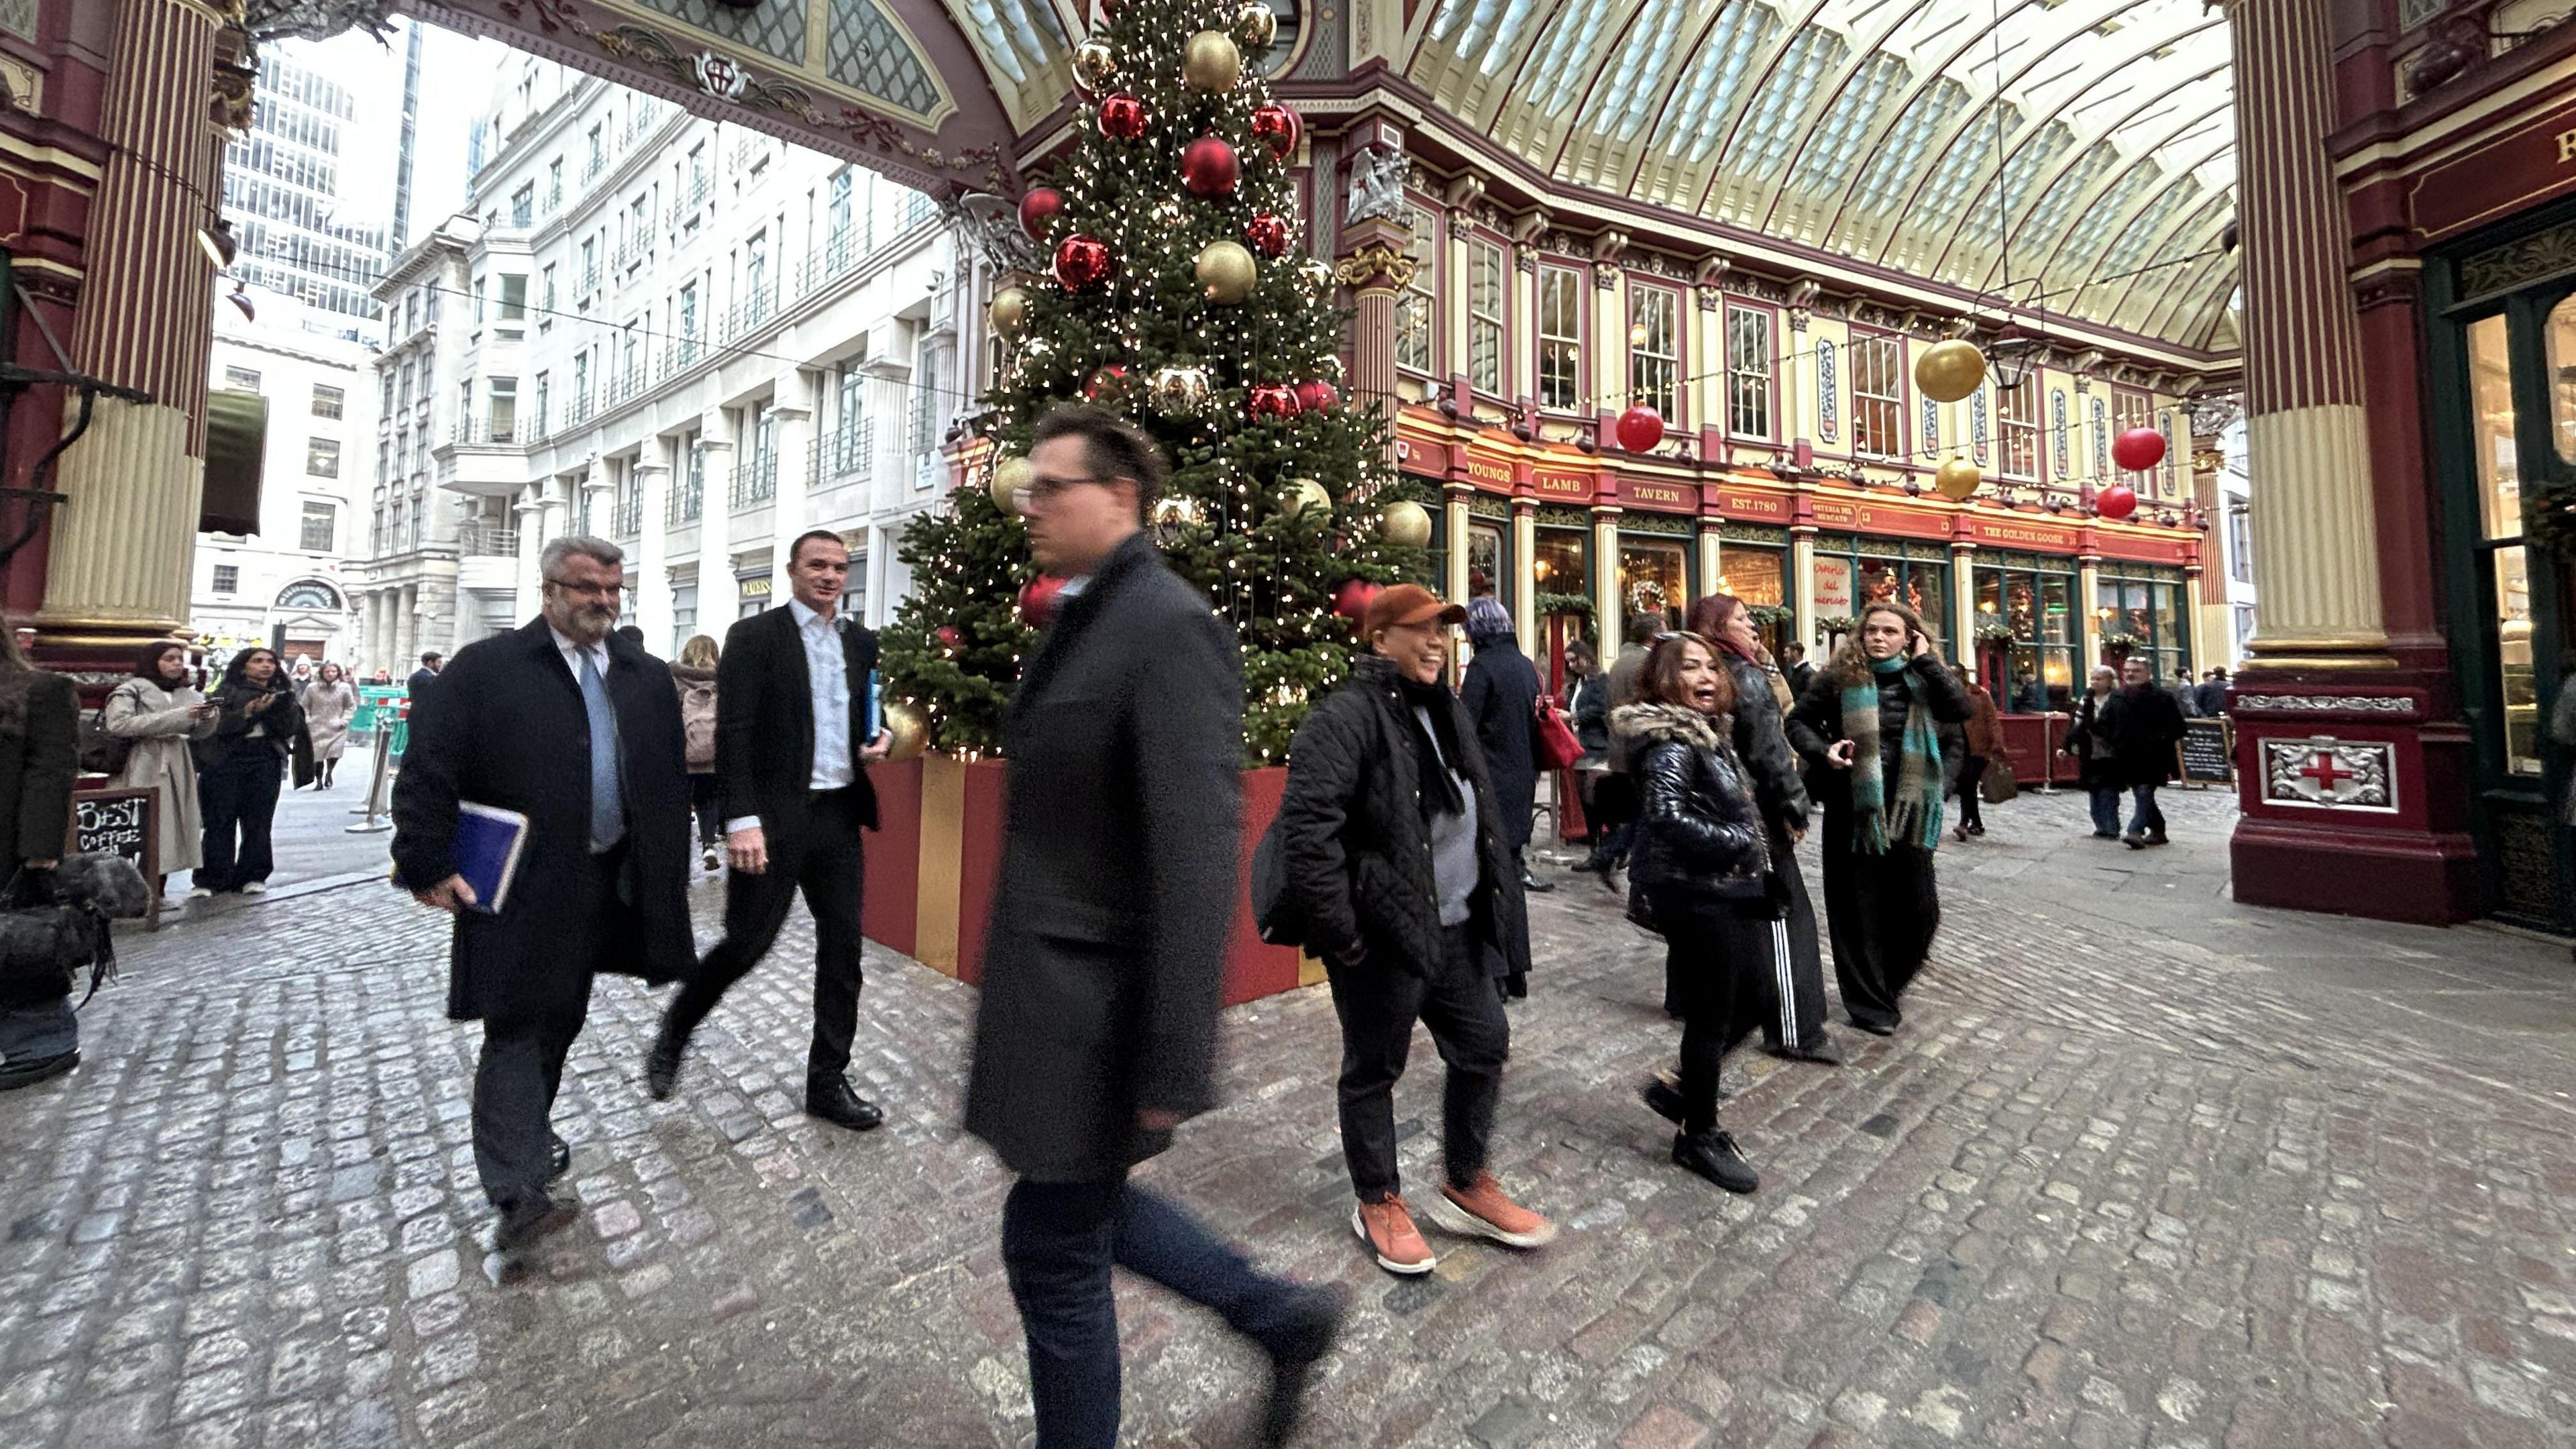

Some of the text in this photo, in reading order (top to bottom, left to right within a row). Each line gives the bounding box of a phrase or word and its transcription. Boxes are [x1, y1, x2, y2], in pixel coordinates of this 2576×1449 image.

[1467, 461, 1511, 483] YOUNGS
[1542, 477, 1581, 492] LAMB
[1633, 487, 1680, 502] TAVERN
[1731, 498, 1778, 513] EST.1780
[1812, 504, 1854, 515] OSTERIA DEL
[1817, 513, 1848, 523] MERCATO
[1983, 527, 2064, 545] THE GOLDEN GOOSE
[1814, 563, 1845, 576] Osteria
[1823, 580, 1839, 591] del
[76, 798, 147, 831] BEST
